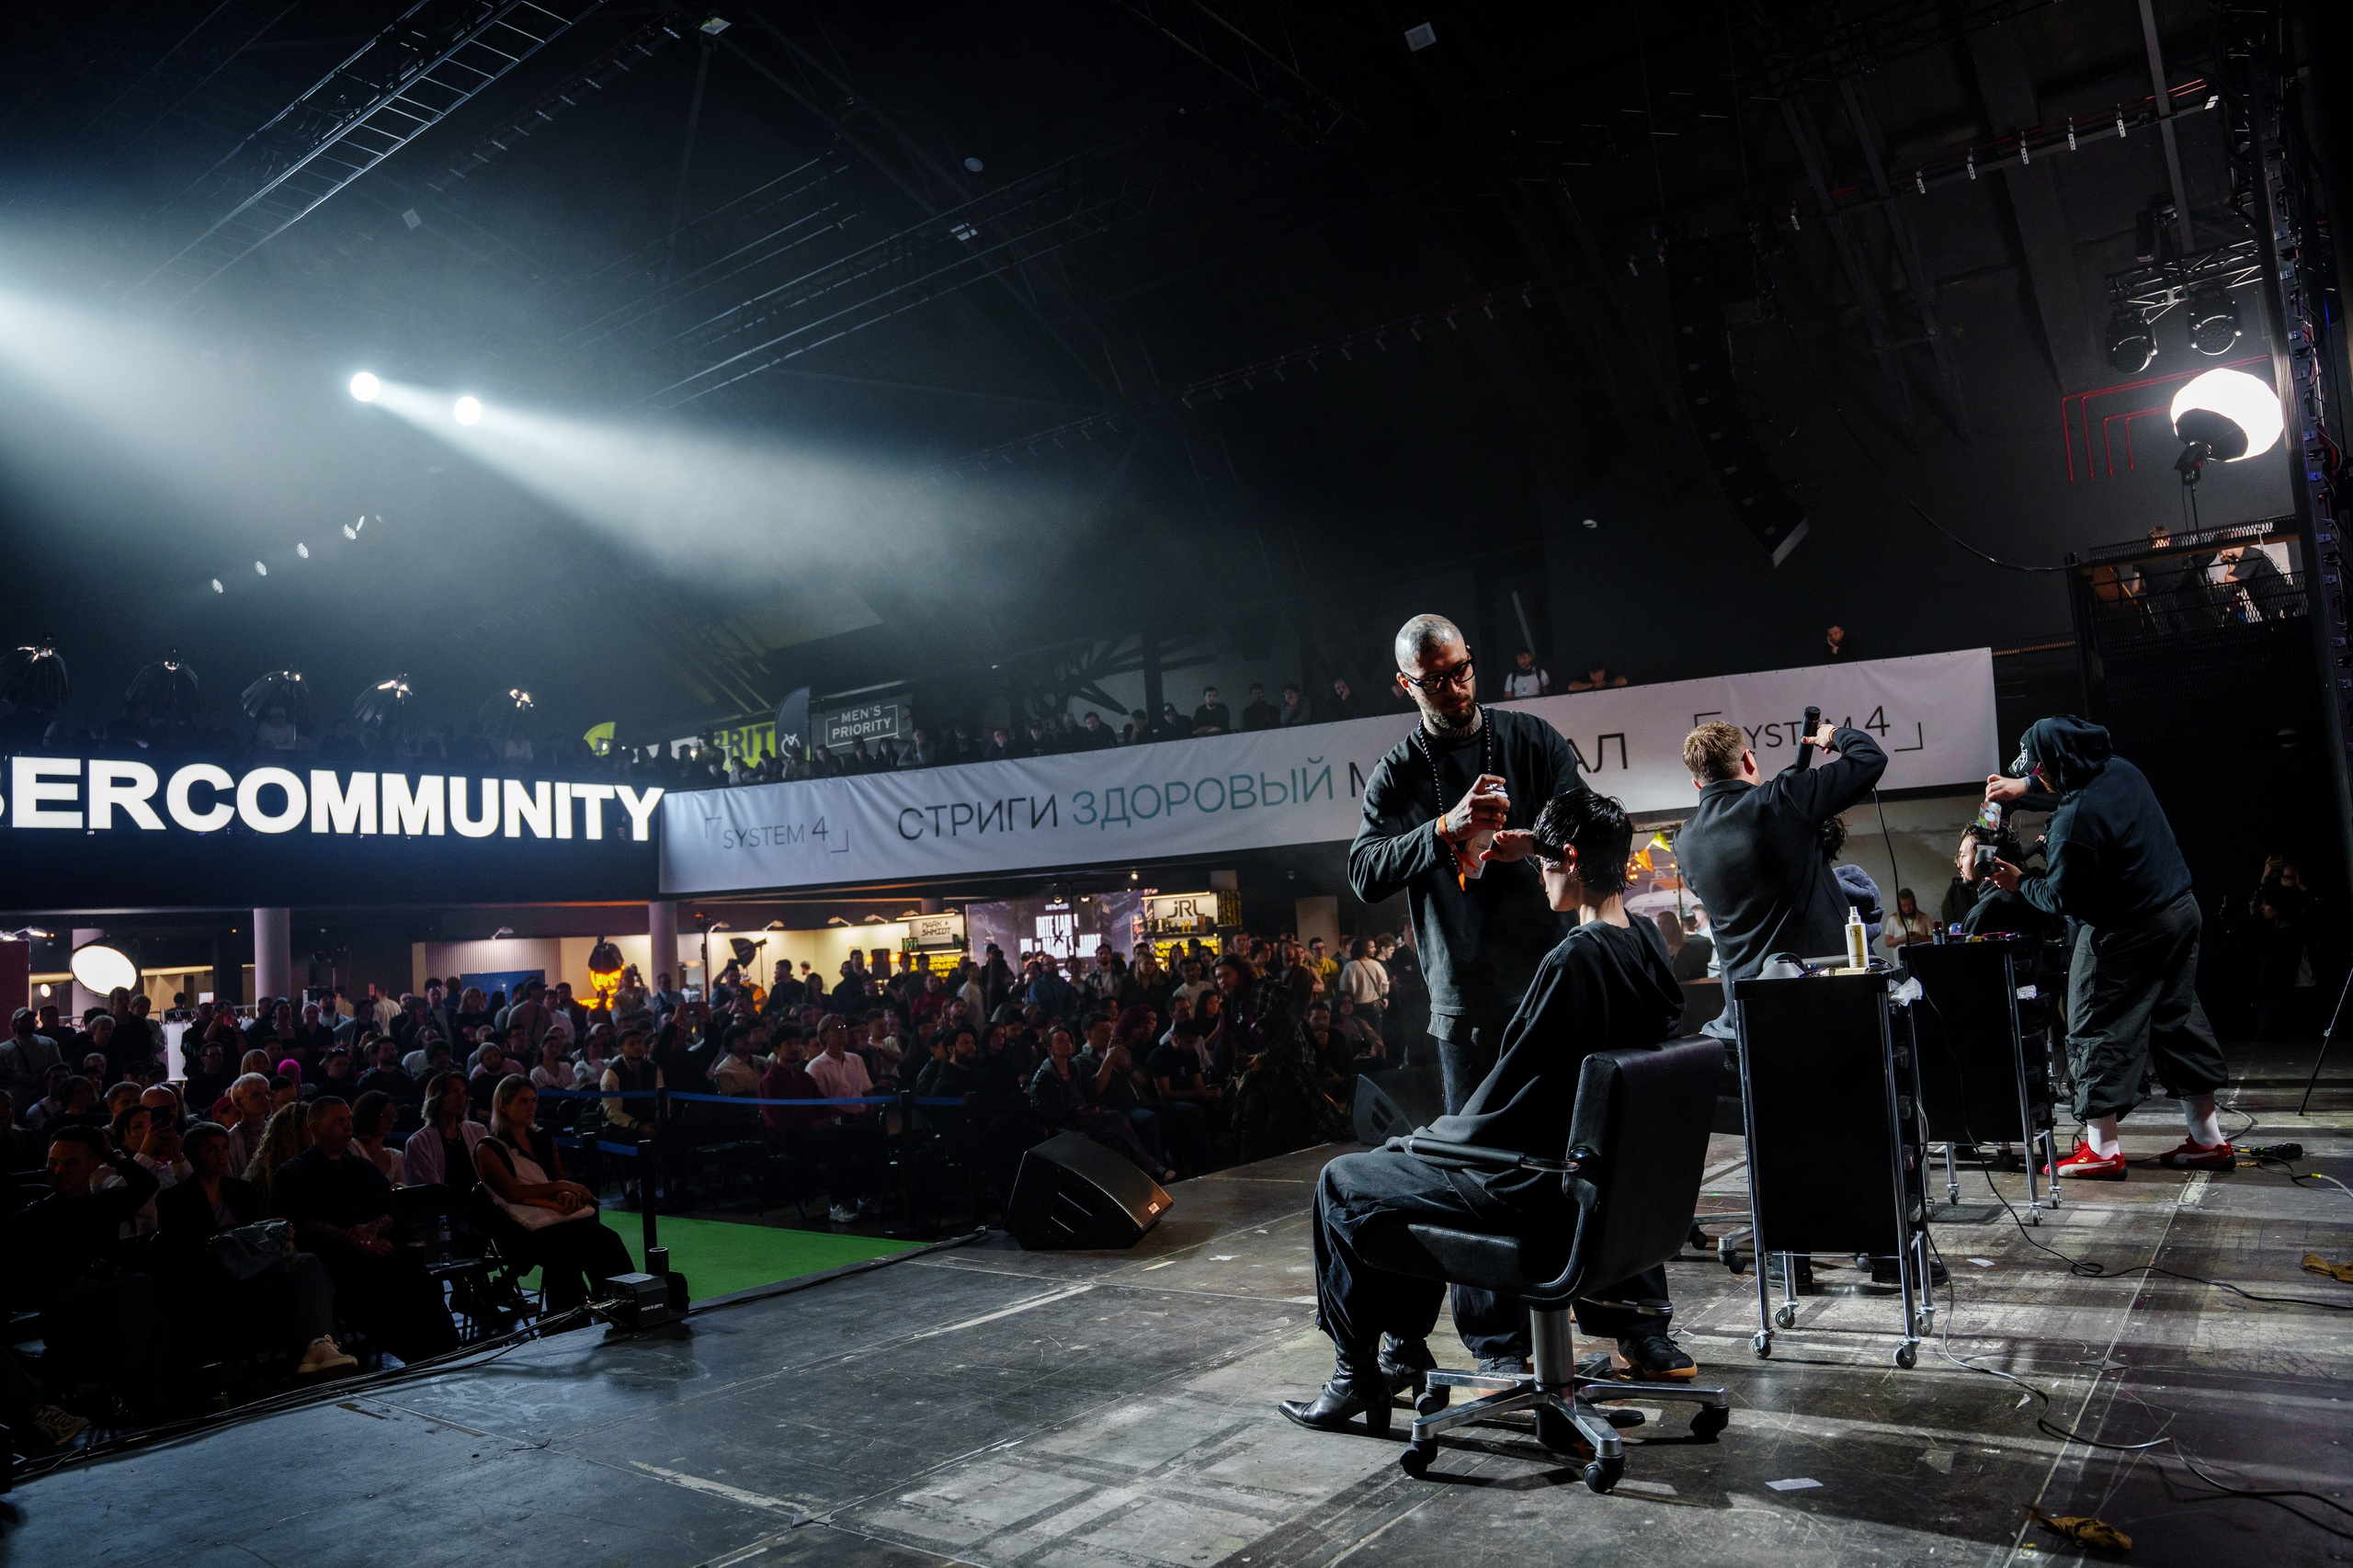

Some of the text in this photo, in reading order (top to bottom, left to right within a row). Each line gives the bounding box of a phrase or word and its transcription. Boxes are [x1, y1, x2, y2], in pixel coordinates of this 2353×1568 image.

[831, 718, 892, 740] PRIORITY
[841, 705, 881, 723] MEN'S
[1743, 705, 1891, 749] YST 4
[0, 756, 665, 842] ERCOMMUNITY
[897, 794, 1060, 840] СТРИГИ
[1073, 755, 1334, 830] ЗДОРОВЫЙ
[722, 816, 830, 850] SYSTEM 4
[922, 927, 951, 936] SHMIDT
